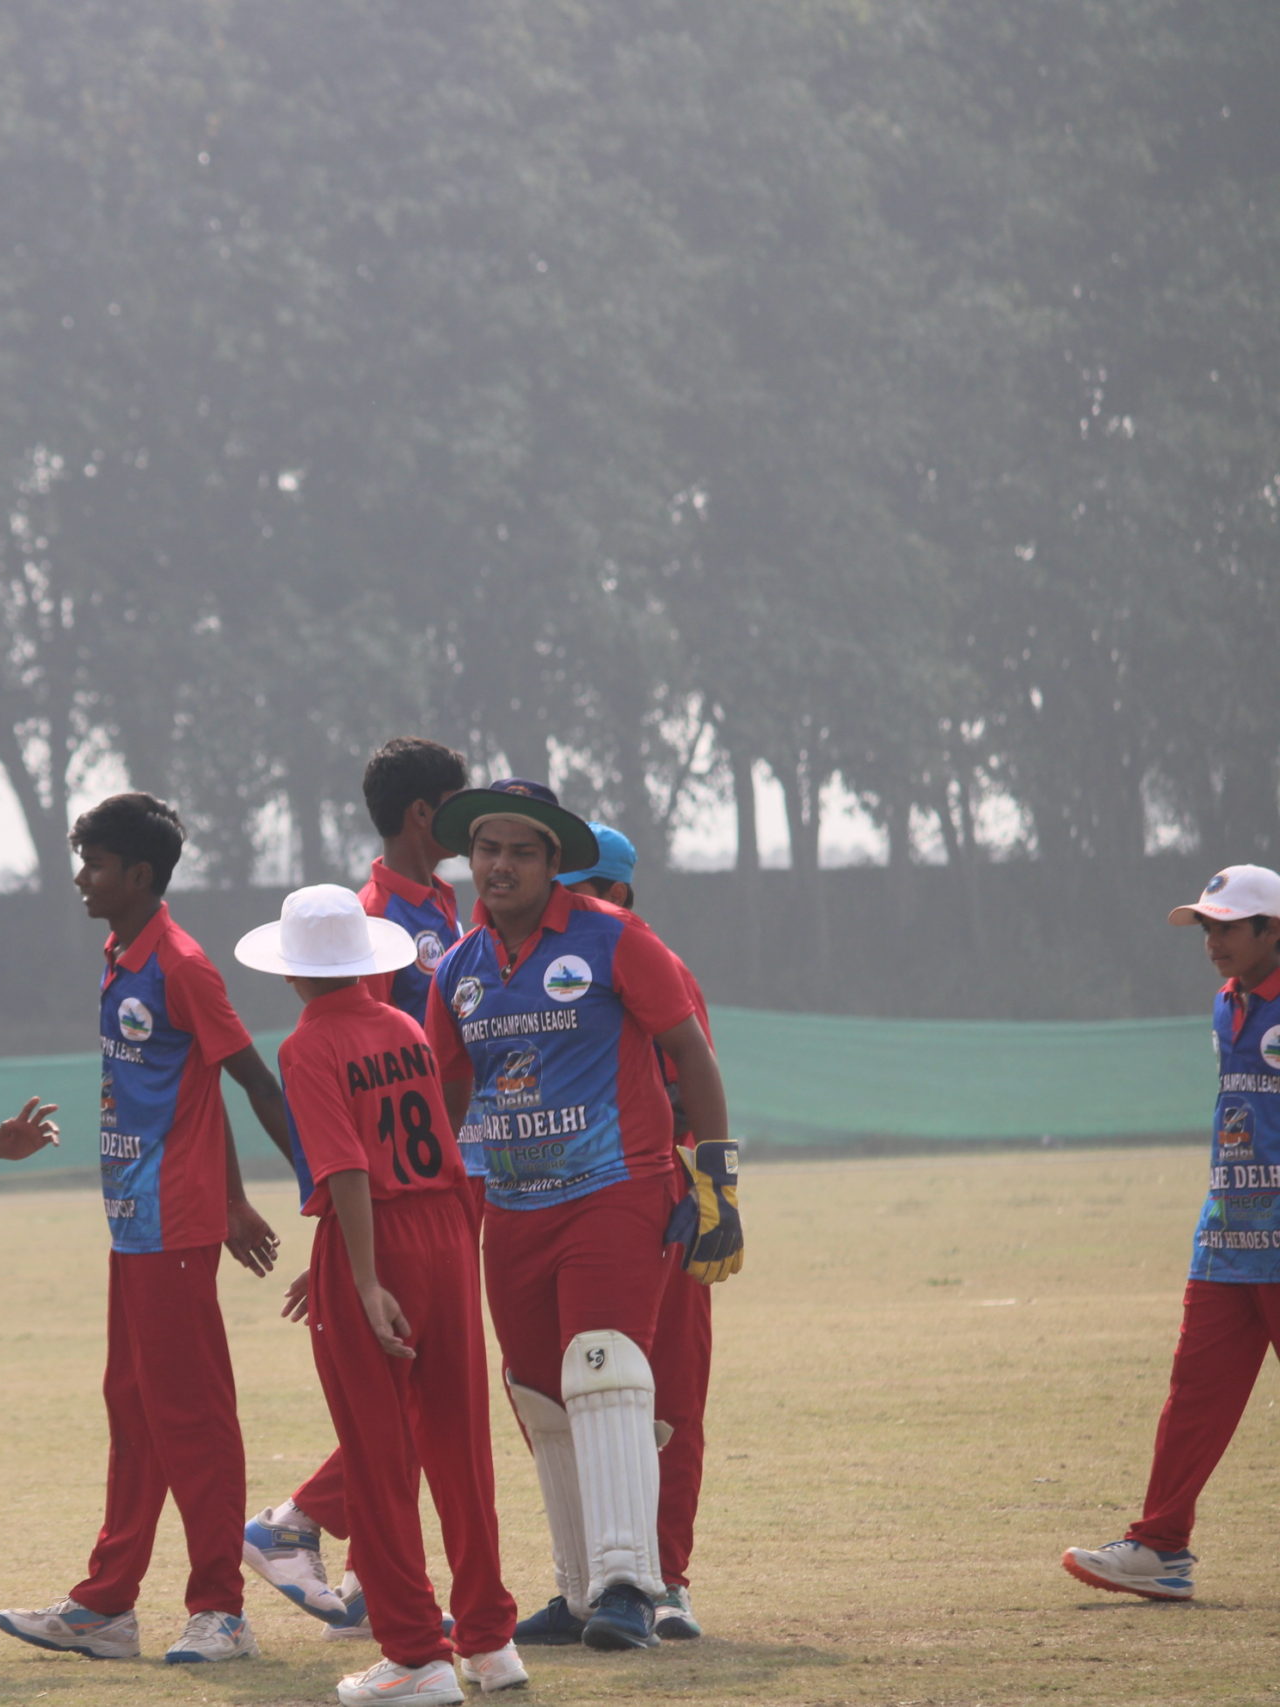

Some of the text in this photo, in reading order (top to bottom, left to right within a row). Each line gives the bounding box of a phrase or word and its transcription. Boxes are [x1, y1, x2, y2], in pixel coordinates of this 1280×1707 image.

[490, 1013, 540, 1037] CHAMPIONS
[540, 1009, 578, 1031] LEAGUE
[516, 1107, 588, 1139] DELHI
[101, 1131, 141, 1159] DELHI
[378, 1090, 443, 1185] 18
[1224, 1230, 1270, 1250] HEROES
